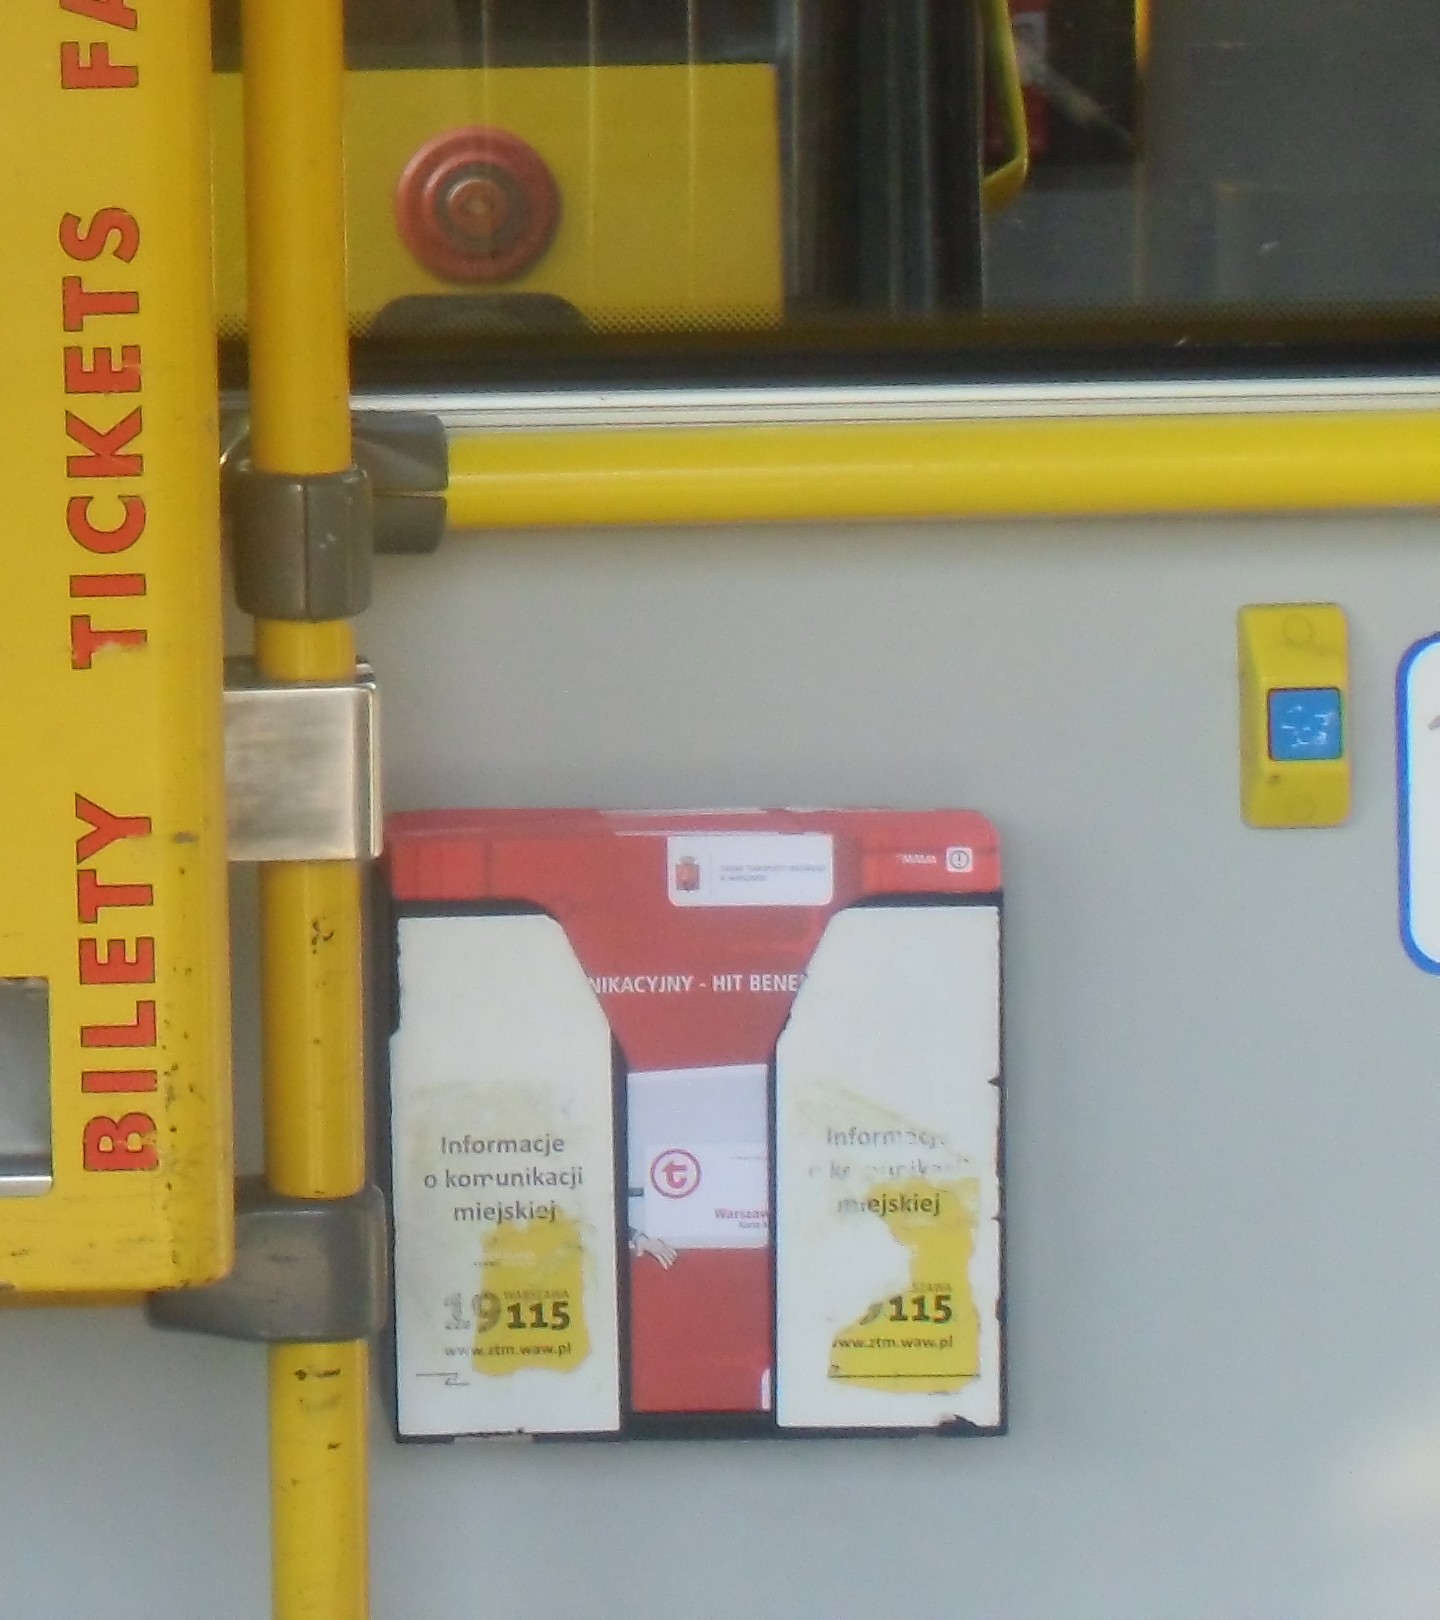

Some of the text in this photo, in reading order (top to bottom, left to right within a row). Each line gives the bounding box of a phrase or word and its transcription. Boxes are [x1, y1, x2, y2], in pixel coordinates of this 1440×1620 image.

[59, 206, 148, 670] TICKETS
[75, 791, 158, 1173] BILETY
[712, 974, 743, 993] HIT
[749, 973, 804, 993] BENE
[440, 1134, 566, 1157] Informacje
[423, 1166, 584, 1190] o komunikacji
[453, 1200, 557, 1225] miejskiej
